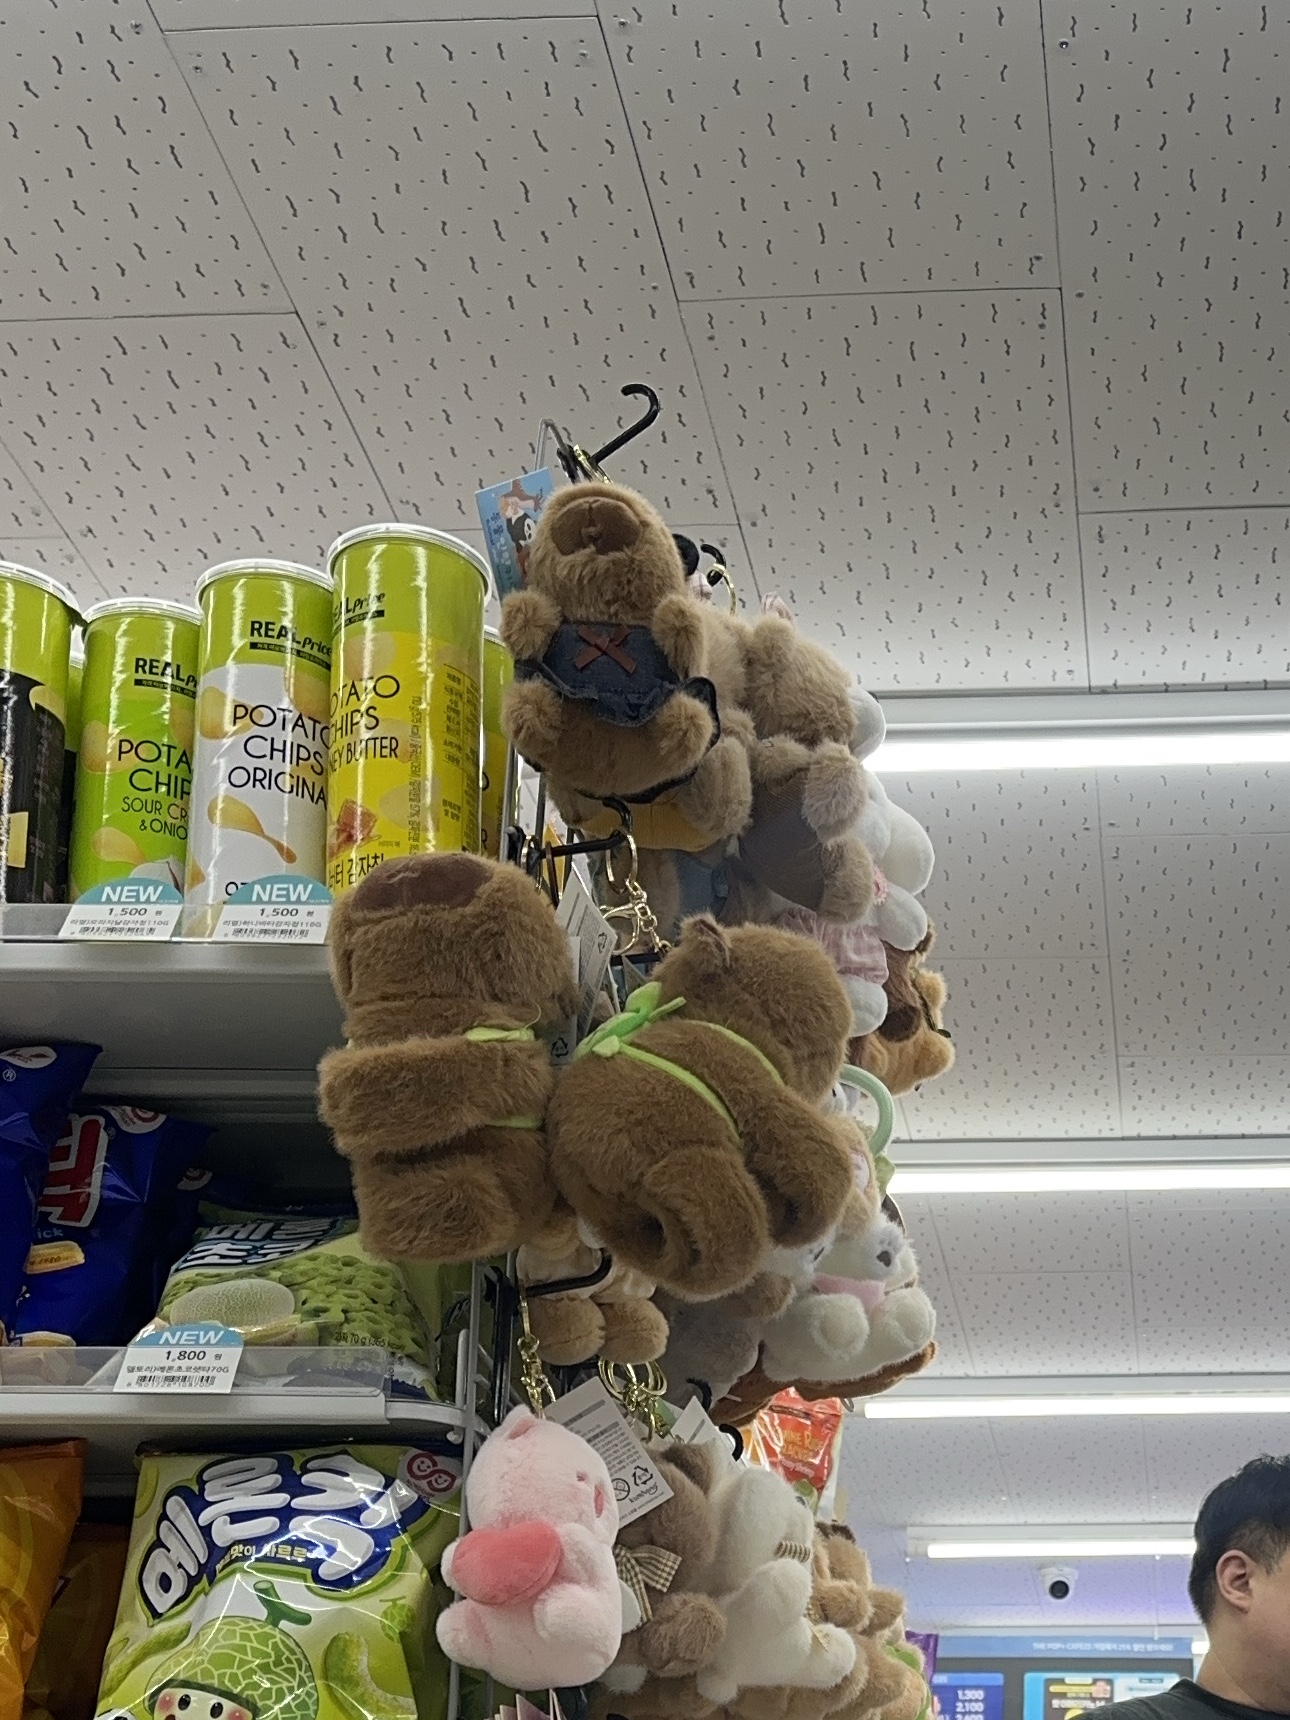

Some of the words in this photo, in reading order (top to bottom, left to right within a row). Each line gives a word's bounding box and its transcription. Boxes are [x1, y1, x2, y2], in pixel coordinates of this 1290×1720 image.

[250, 620, 301, 647] REAL
[134, 657, 190, 678] REAL
[244, 735, 324, 776] CHIPS
[345, 737, 399, 764] BUTTER
[122, 796, 162, 816] SOUR
[139, 819, 148, 832] &
[101, 886, 163, 903] NEW
[252, 884, 313, 902] NEW
[108, 907, 148, 917] 1,500
[260, 908, 299, 918] 1,500
[159, 1330, 225, 1345] NEW
[166, 1350, 206, 1362] 1,800
